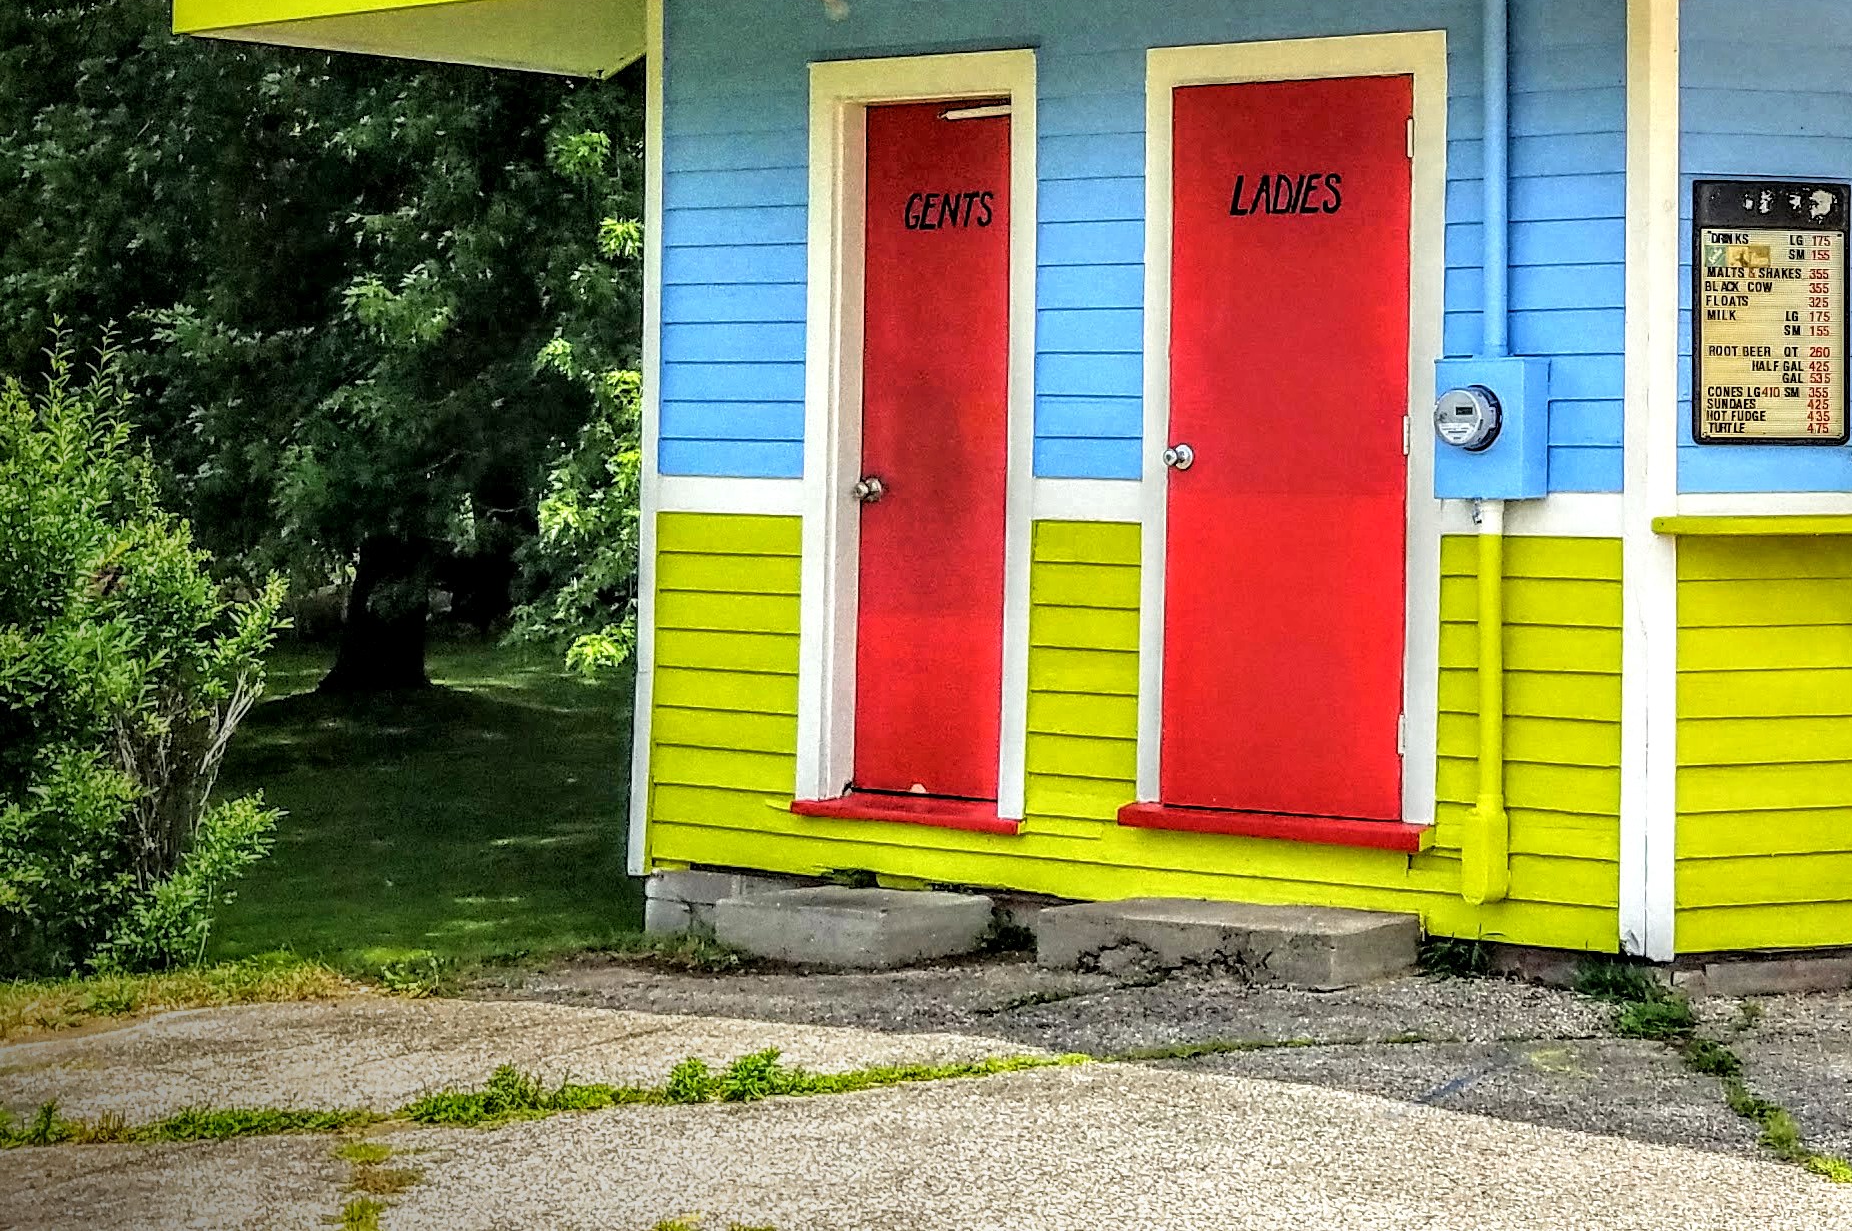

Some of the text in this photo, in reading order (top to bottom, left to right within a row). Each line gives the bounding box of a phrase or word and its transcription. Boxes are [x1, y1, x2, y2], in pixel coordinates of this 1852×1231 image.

[1229, 173, 1342, 217] LADIES
[904, 191, 995, 231] GENTS
[1711, 233, 1831, 246] DRINKS LG 175
[1788, 249, 1830, 260] SM 155
[1706, 267, 1744, 278] MALTS
[1758, 268, 1802, 279] SHAKES
[1809, 268, 1829, 279] 355
[1705, 281, 1829, 294] BLACK COW 355
[1706, 295, 1829, 308] FLOATS 325
[1707, 310, 1830, 322] MILK LG 175
[1784, 325, 1830, 336] SM 155
[1708, 346, 1830, 358] ROOT BEER QT 260
[1752, 360, 1829, 371] HALF GAL 425
[1782, 373, 1831, 384] GAL 535
[1708, 387, 1829, 398] CONES LG 410 SM 355
[1707, 399, 1829, 410] SUNDAES 425
[1706, 410, 1830, 422] HOT FUDGE 435
[1709, 423, 1829, 434] TURTLE 475
